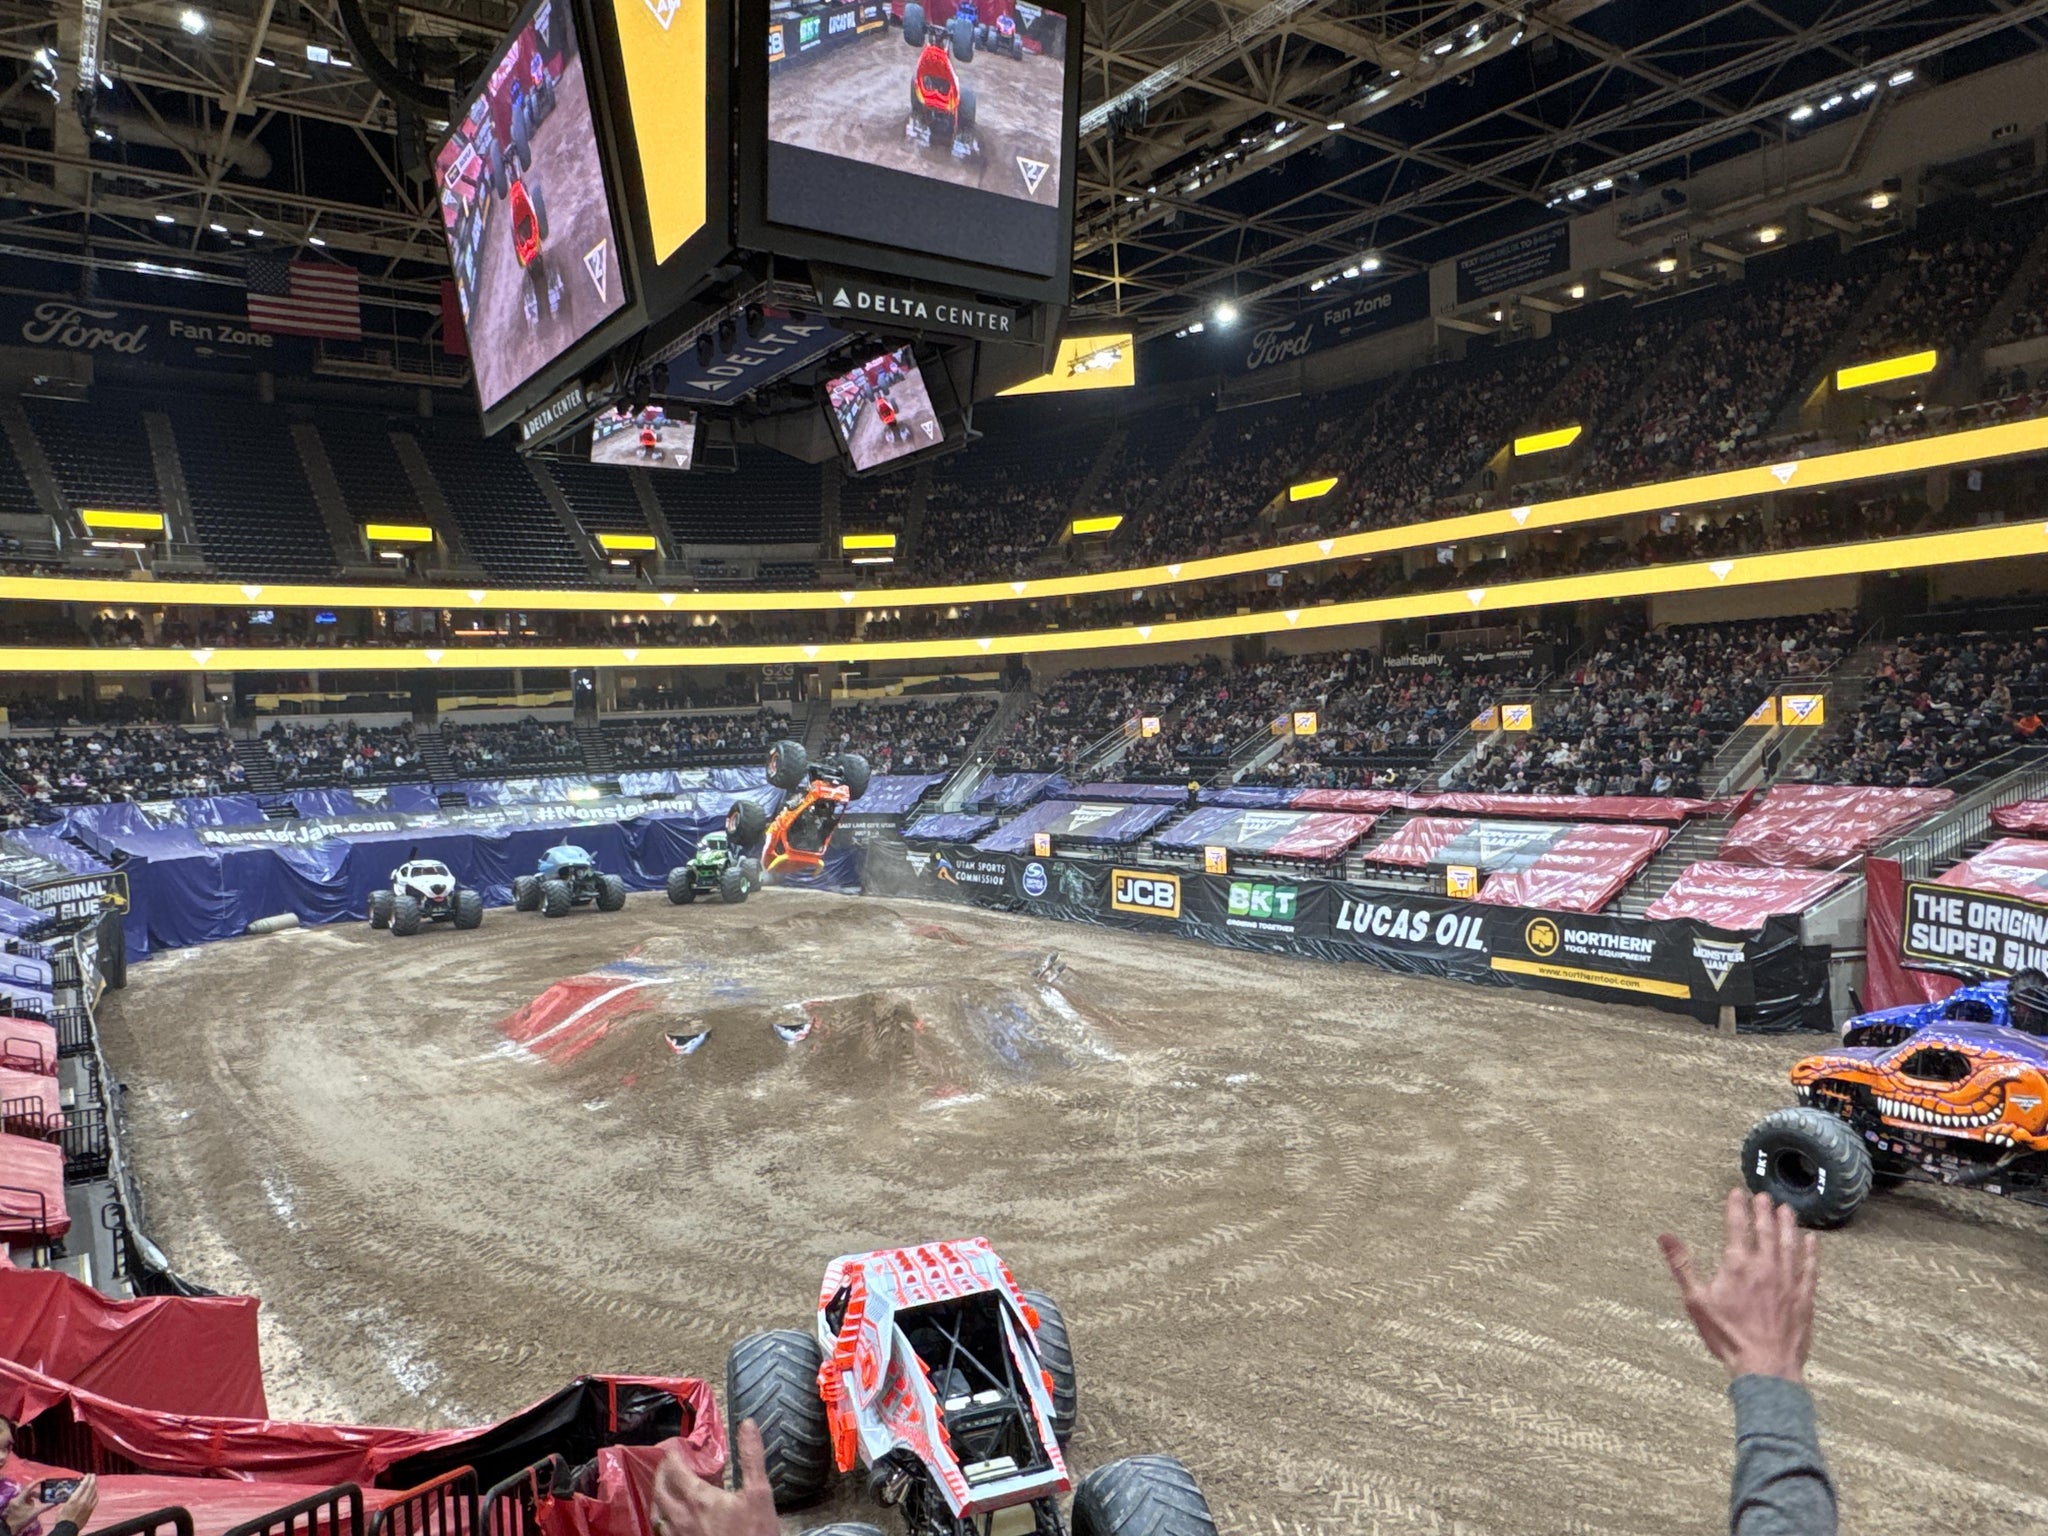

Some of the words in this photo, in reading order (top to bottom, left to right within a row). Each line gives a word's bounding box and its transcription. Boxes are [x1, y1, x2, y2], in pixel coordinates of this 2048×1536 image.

[857, 291, 928, 319] DELTA
[935, 304, 1010, 332] CENTER
[22, 301, 149, 354] Ford
[169, 319, 213, 342] Fan
[217, 325, 273, 348] Zone
[1247, 321, 1314, 369] Ford
[1324, 308, 1351, 326] Fan
[1354, 293, 1392, 317] Zone
[706, 324, 825, 377] DELTA
[528, 408, 554, 435] DELTA
[552, 389, 581, 419] CENTER
[761, 664, 794, 676] G2G
[1383, 653, 1445, 667] HealthEquity
[536, 800, 693, 821] #MonsterJam
[204, 820, 397, 844] MonsterJam.com
[955, 871, 1004, 886] COMMISSION
[956, 860, 976, 870] UTAH
[978, 862, 1006, 874] SPORTS
[42, 880, 106, 905] ORIGINAL
[1117, 879, 1174, 908] JCB
[1229, 887, 1296, 914] BKT
[1914, 893, 1964, 925] THE
[1258, 922, 1295, 933] TOGETHER
[1336, 900, 1431, 942] LUCAS
[1435, 913, 1484, 950] OIL
[1564, 929, 1652, 953] NORTHERN
[1564, 944, 1589, 954] TOOL
[1598, 949, 1652, 962] EQUIPMENT
[1911, 922, 1997, 963] SUPER
[1693, 946, 1745, 962] MONSTER
[1703, 959, 1729, 971] JAM
[1538, 966, 1640, 988] www.northerntool.com
[1756, 1149, 1768, 1177] BKT
[1817, 1167, 1826, 1195] BKT
